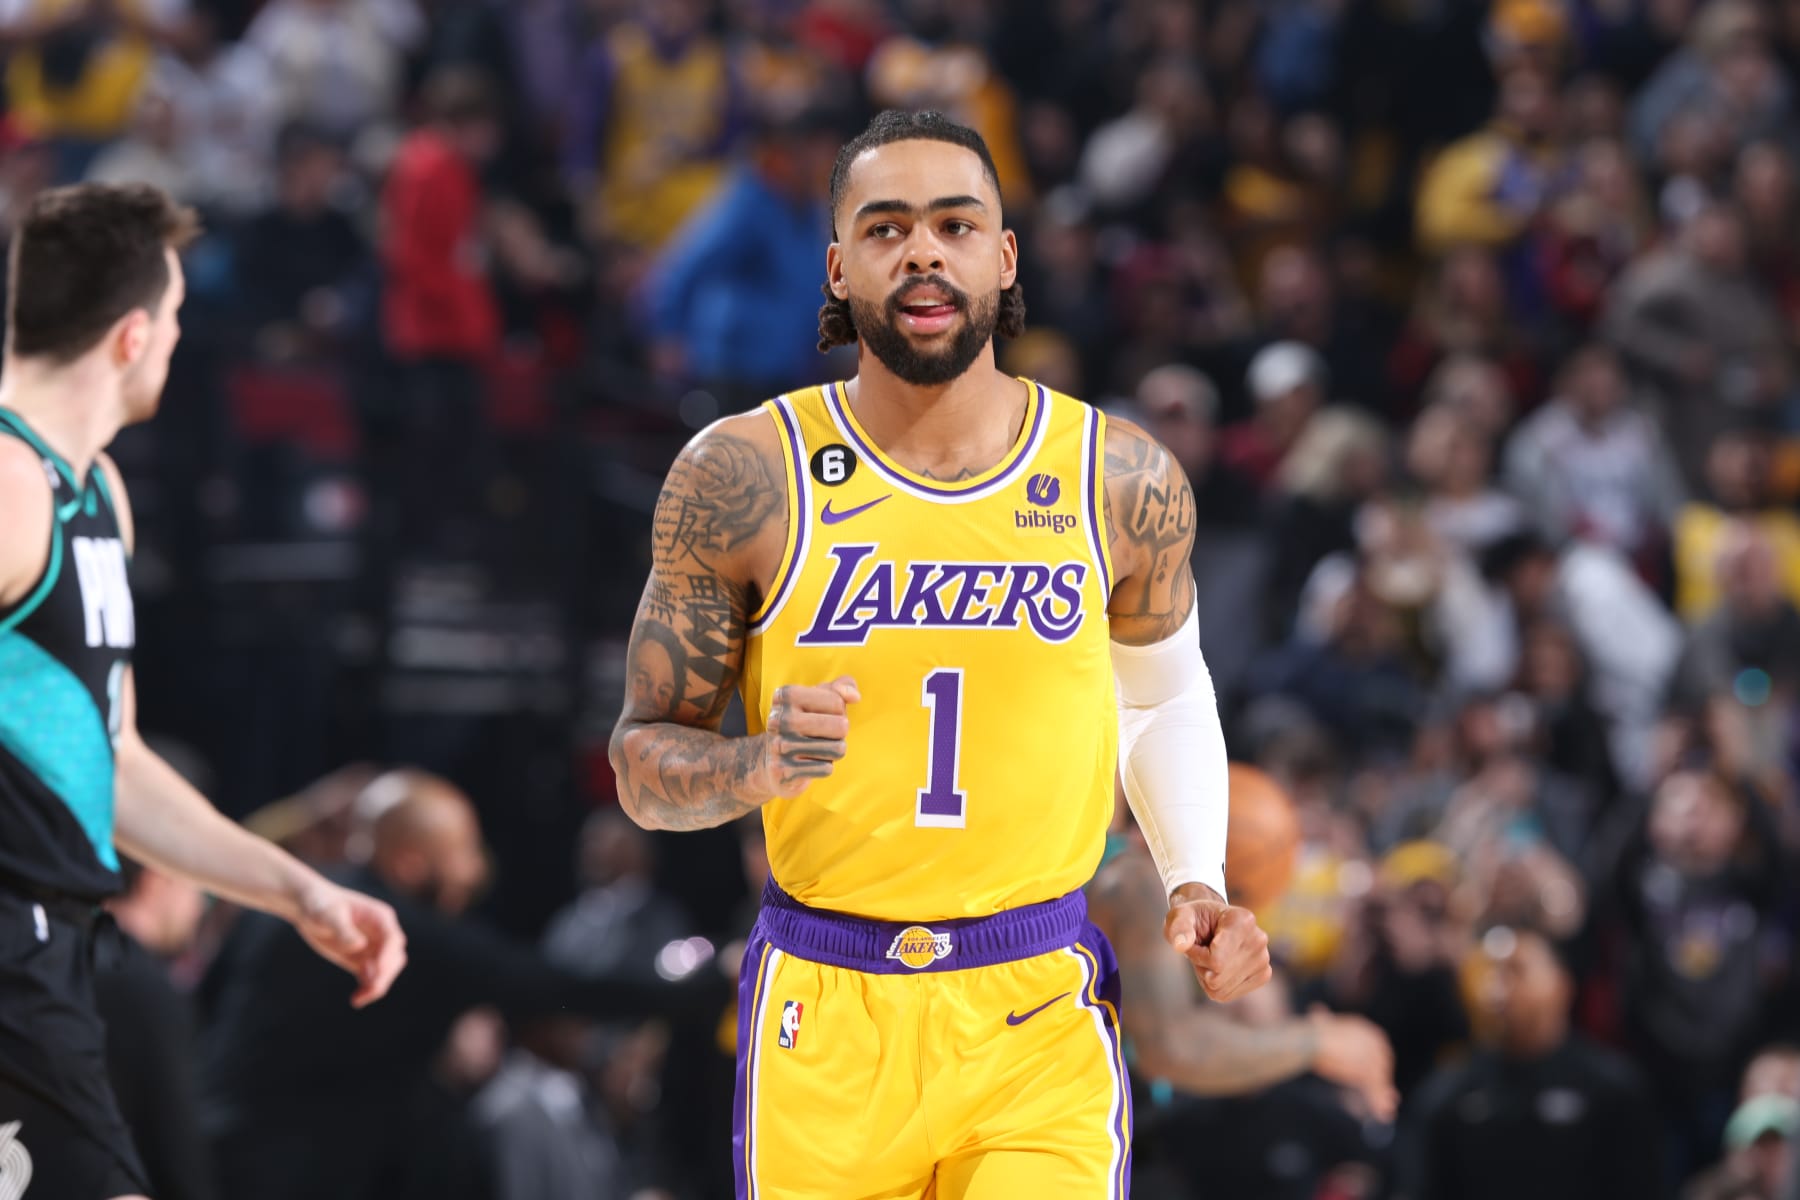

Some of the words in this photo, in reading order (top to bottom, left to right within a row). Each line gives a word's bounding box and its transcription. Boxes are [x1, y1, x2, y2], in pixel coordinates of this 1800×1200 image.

[821, 450, 846, 482] 6
[1014, 511, 1077, 534] bibigo
[796, 543, 1088, 646] LAKERS
[915, 667, 967, 829] 1
[889, 936, 950, 957] LAKERS
